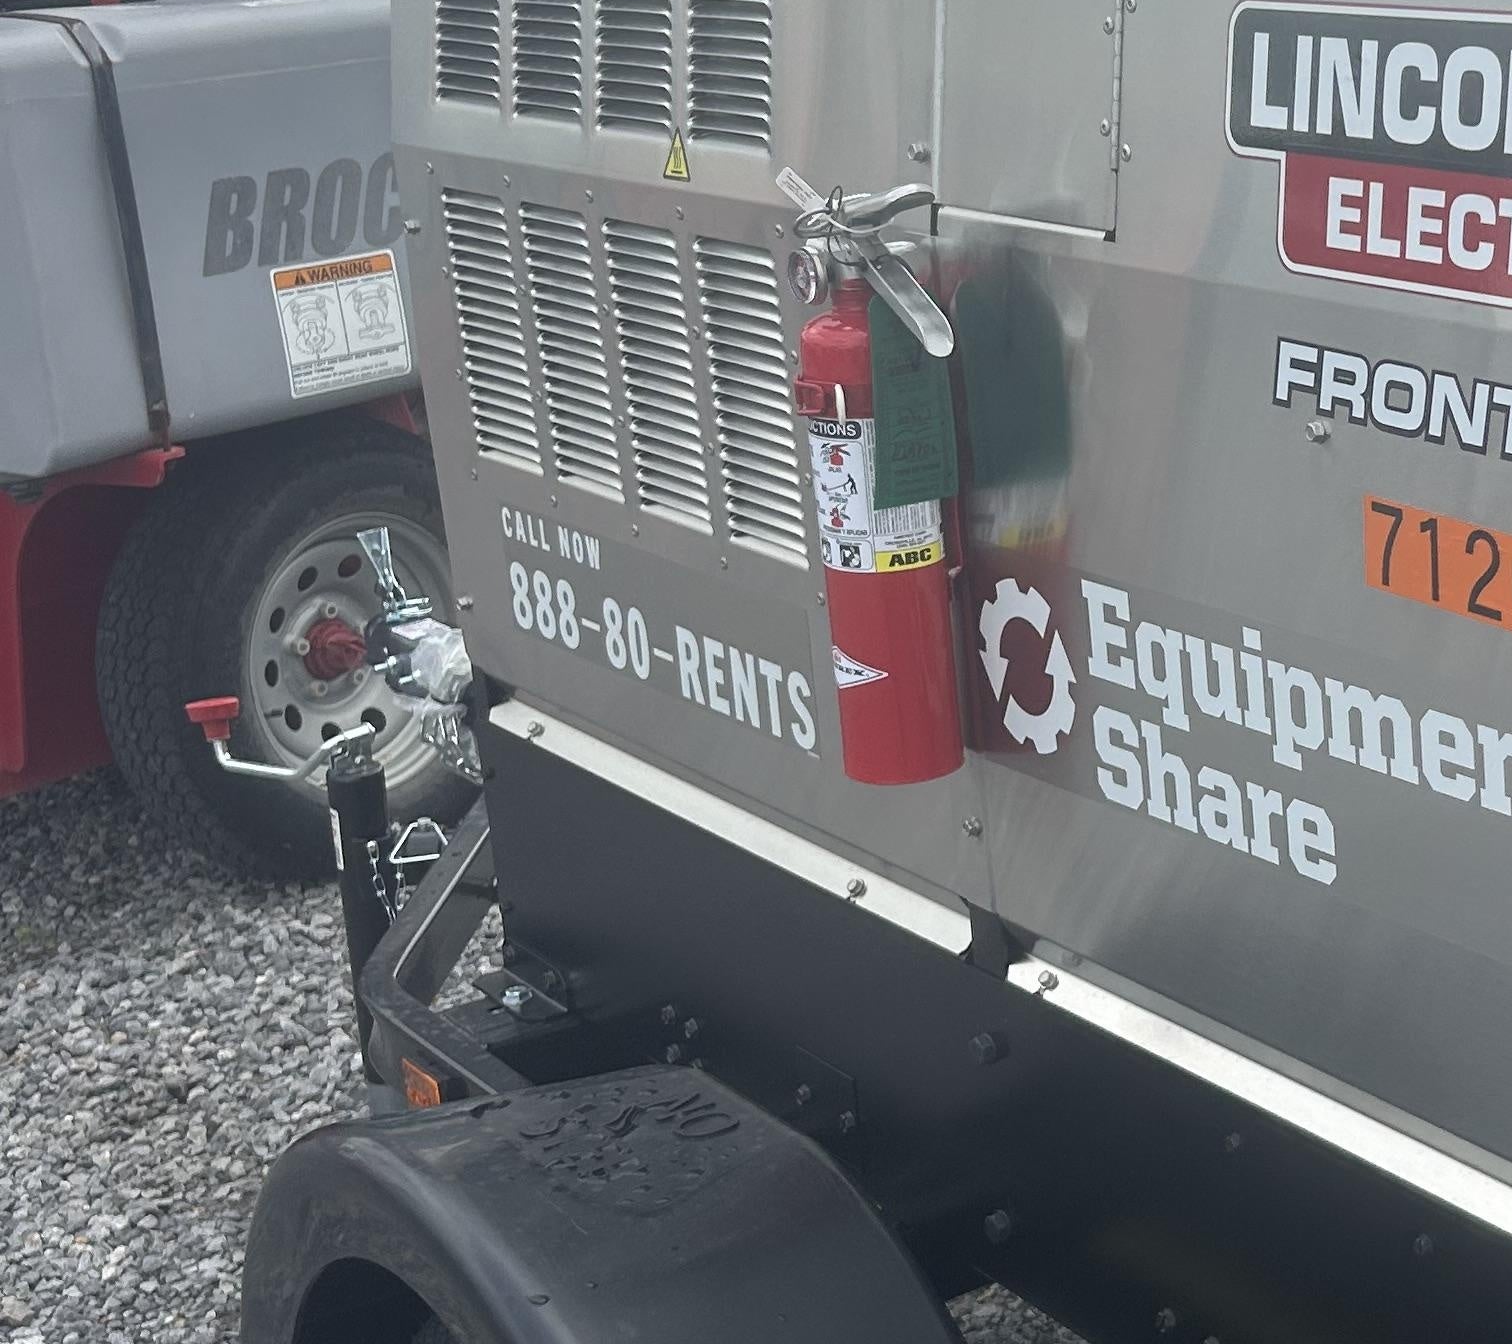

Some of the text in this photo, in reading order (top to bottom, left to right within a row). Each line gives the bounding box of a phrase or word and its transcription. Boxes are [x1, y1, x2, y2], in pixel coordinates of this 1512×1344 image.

[309, 260, 373, 284] WARNING
[502, 506, 601, 570] CALL NOW
[889, 548, 931, 567] ABC
[510, 560, 817, 751] 888-80-RENTS
[1093, 705, 1338, 886] Share
